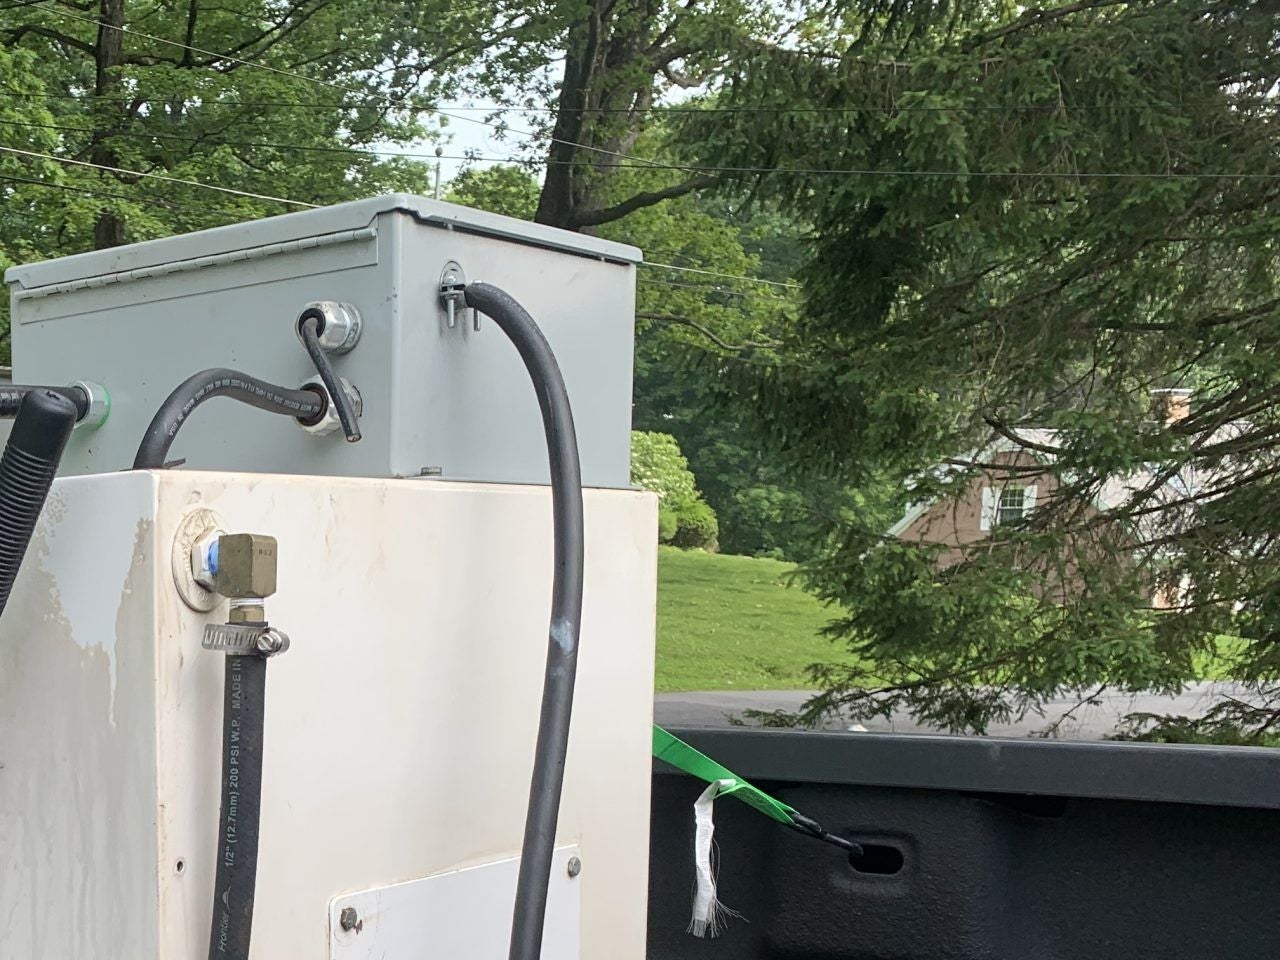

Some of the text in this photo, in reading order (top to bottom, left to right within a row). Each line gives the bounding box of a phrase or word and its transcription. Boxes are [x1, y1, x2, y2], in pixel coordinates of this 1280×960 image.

[232, 659, 242, 671] IN
[232, 673, 242, 709] MADE
[231, 715, 241, 743] W.P.
[230, 744, 240, 765] PSI
[229, 768, 240, 788] 200
[225, 791, 240, 843] (12.7mm)
[224, 845, 235, 868] 1/2"
[216, 911, 230, 952] Frontier
